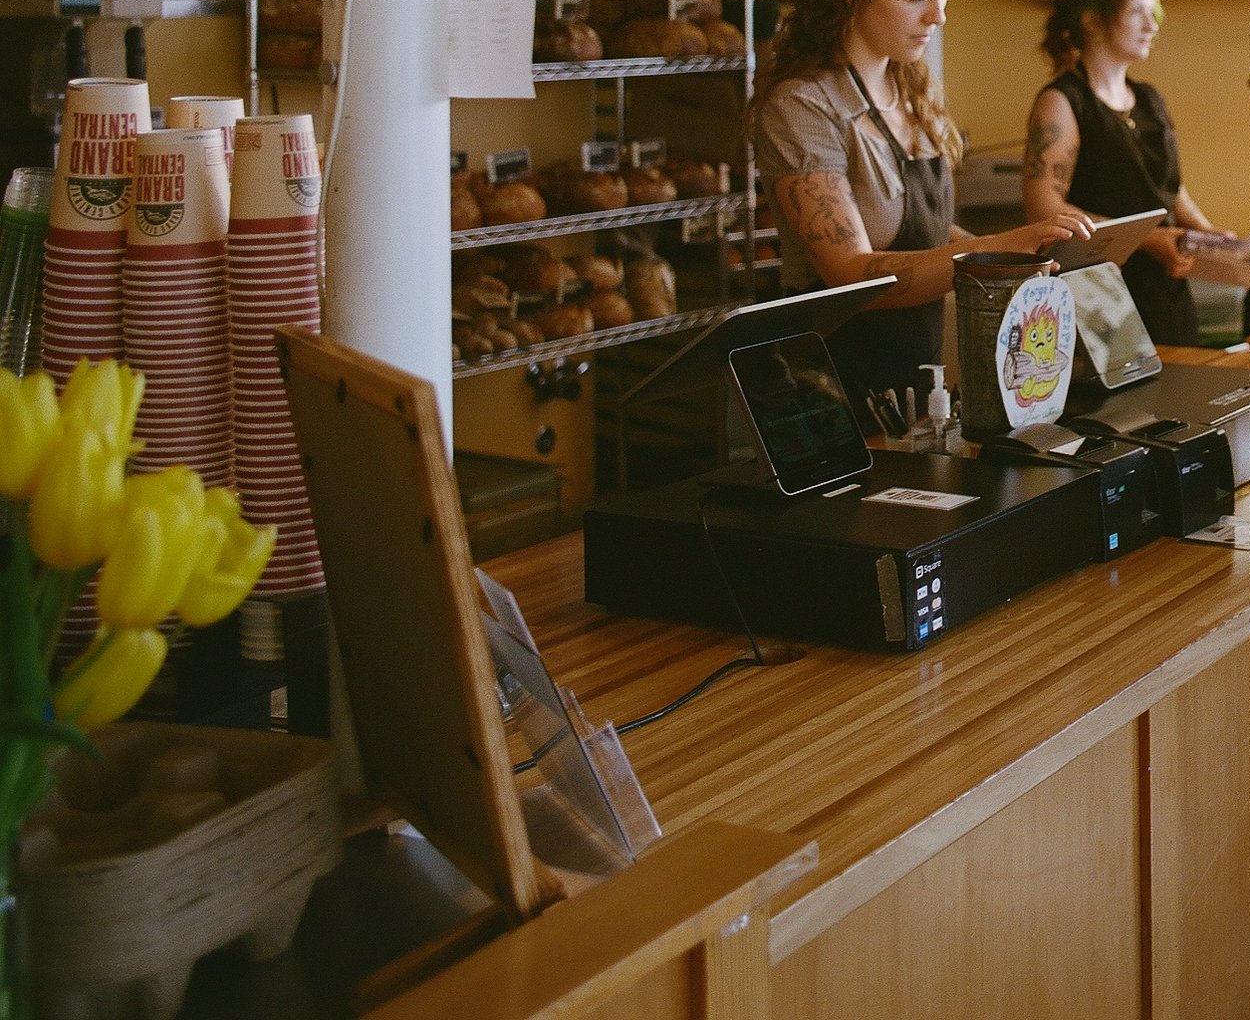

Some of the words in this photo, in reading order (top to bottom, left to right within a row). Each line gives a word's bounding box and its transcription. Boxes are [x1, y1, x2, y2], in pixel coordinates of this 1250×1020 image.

[72, 112, 138, 140] CENTRAL
[69, 140, 136, 176] GRAND
[138, 153, 186, 175] CENTRAL
[136, 175, 185, 202] GRAND
[923, 560, 942, 574] Square
